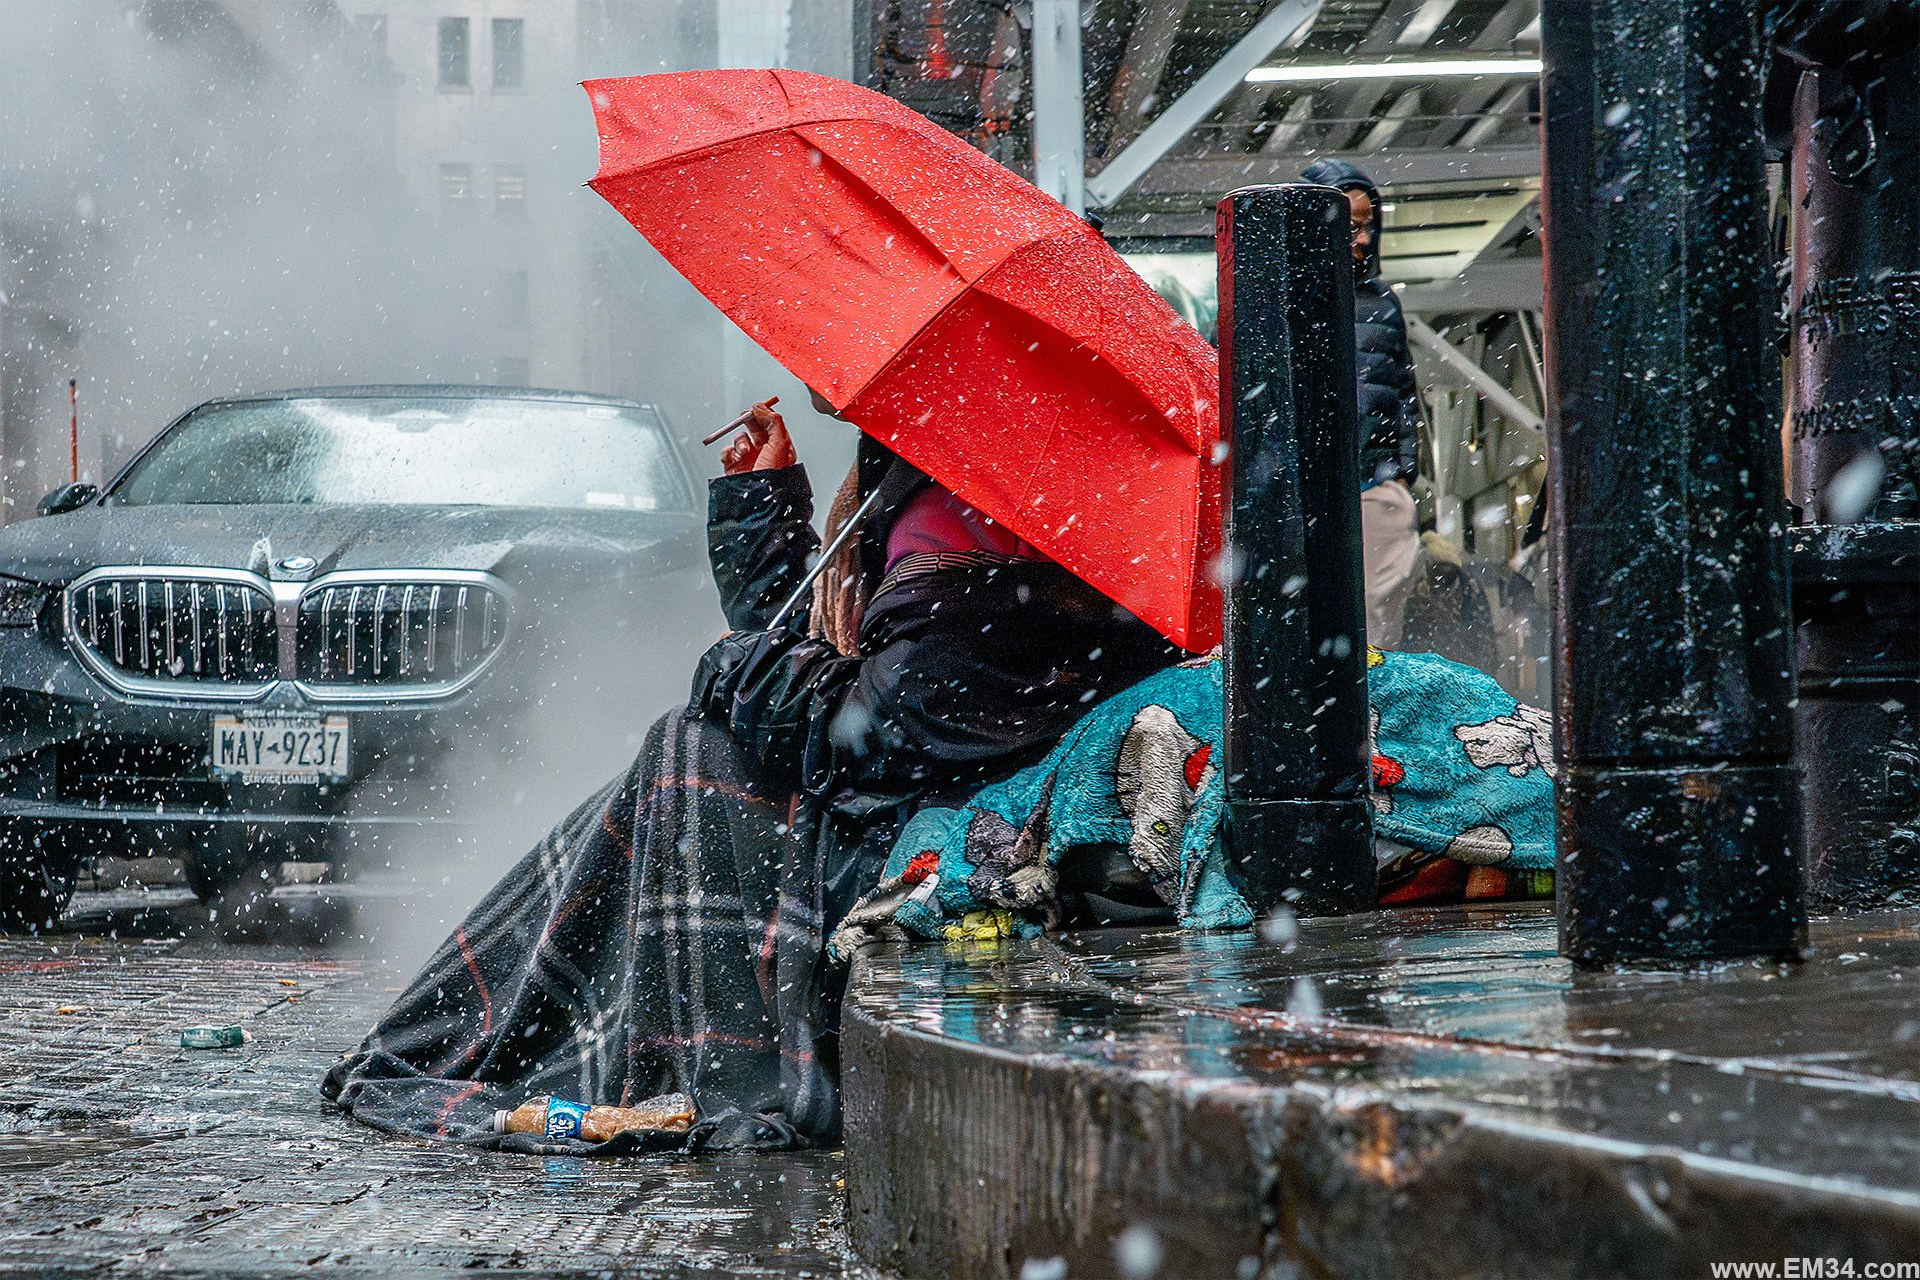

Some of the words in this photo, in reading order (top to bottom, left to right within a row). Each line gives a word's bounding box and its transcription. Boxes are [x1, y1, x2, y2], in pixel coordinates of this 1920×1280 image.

[246, 718, 277, 728] NEW
[283, 718, 317, 728] YORK
[221, 730, 264, 765] MAY
[283, 730, 341, 765] 9237
[556, 1119, 568, 1138] Life
